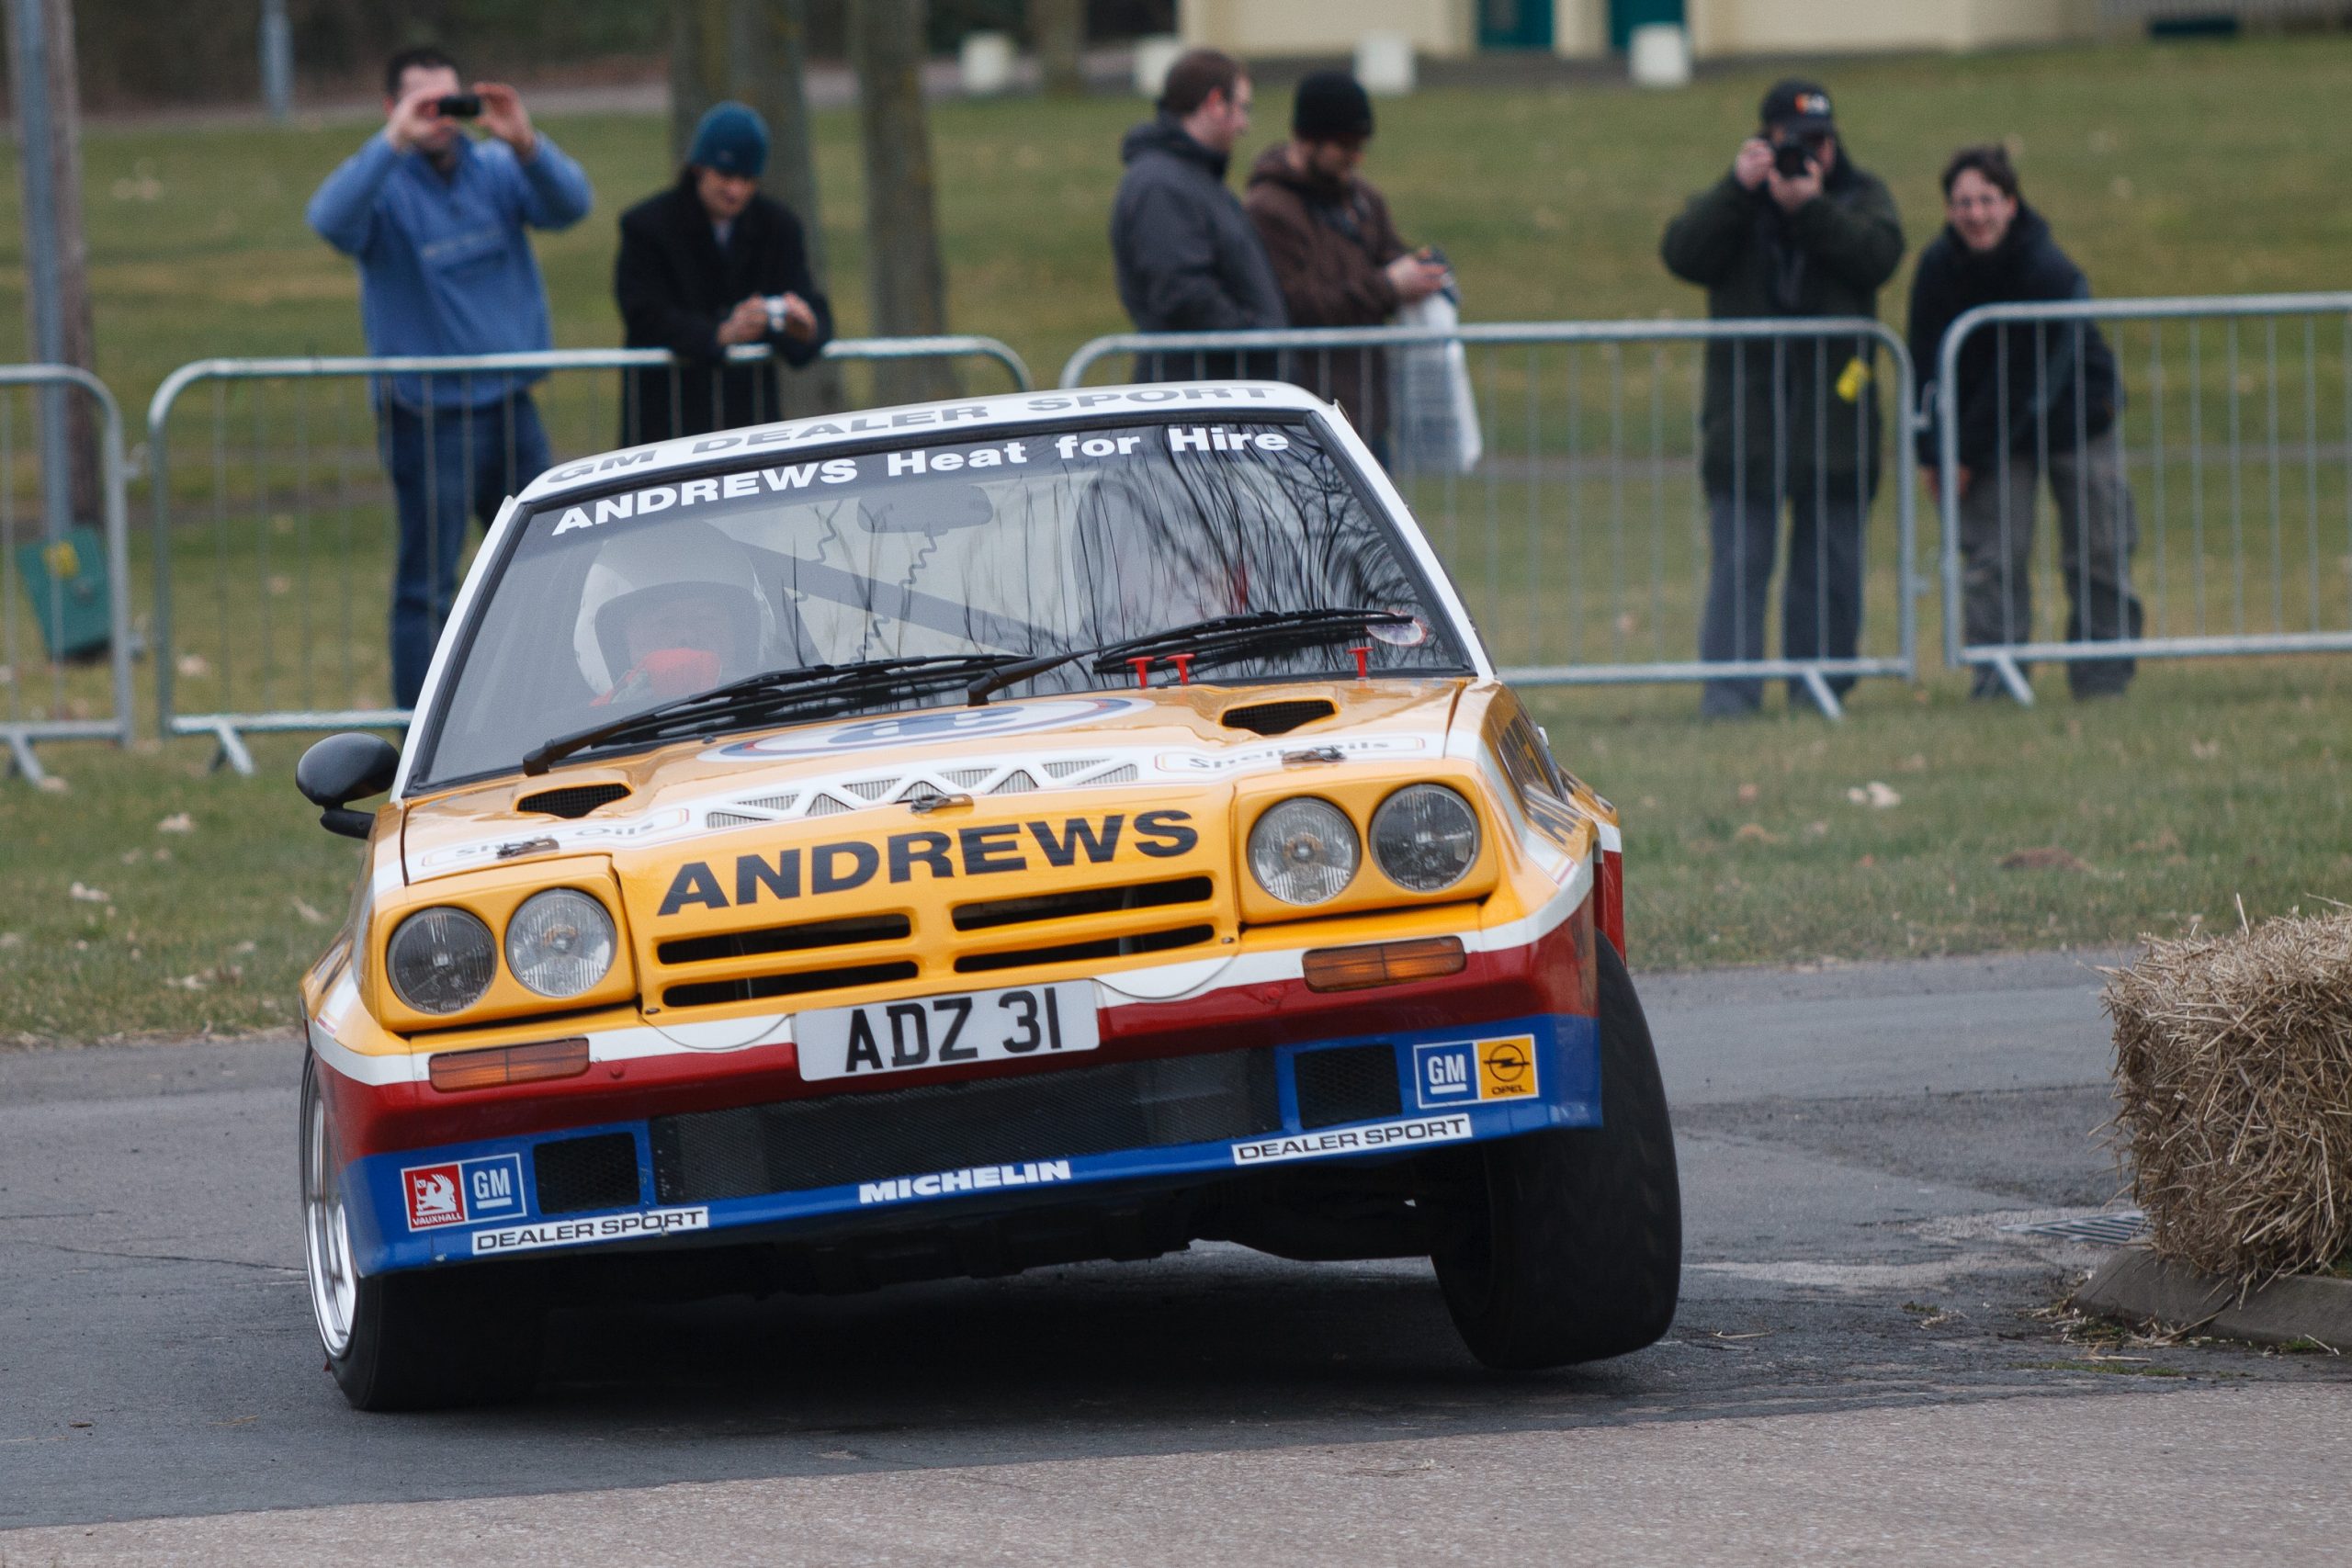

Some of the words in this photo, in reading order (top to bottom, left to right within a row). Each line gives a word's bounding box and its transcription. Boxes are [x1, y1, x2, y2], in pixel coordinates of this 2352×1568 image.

[547, 449, 655, 483] GM
[692, 405, 989, 455] DEALER
[1027, 387, 1275, 412] SPORT
[552, 457, 857, 536] ANDREWS
[888, 442, 1027, 476] Heat
[1056, 434, 1140, 460] for
[1169, 427, 1289, 452] Hire
[657, 809, 1198, 917] ANDREWS
[845, 997, 978, 1073] ADZ
[998, 987, 1063, 1054] 31
[1428, 1053, 1467, 1085] GM
[1491, 1084, 1527, 1095] OPEL
[1238, 1132, 1358, 1160] DEALER
[1364, 1117, 1466, 1145] SPORT
[473, 1168, 511, 1200] GM
[858, 1160, 1071, 1205] MICHELIN
[413, 1212, 463, 1226] VAUXHALL
[477, 1222, 594, 1251] DEALER
[601, 1210, 704, 1235] SPORT
